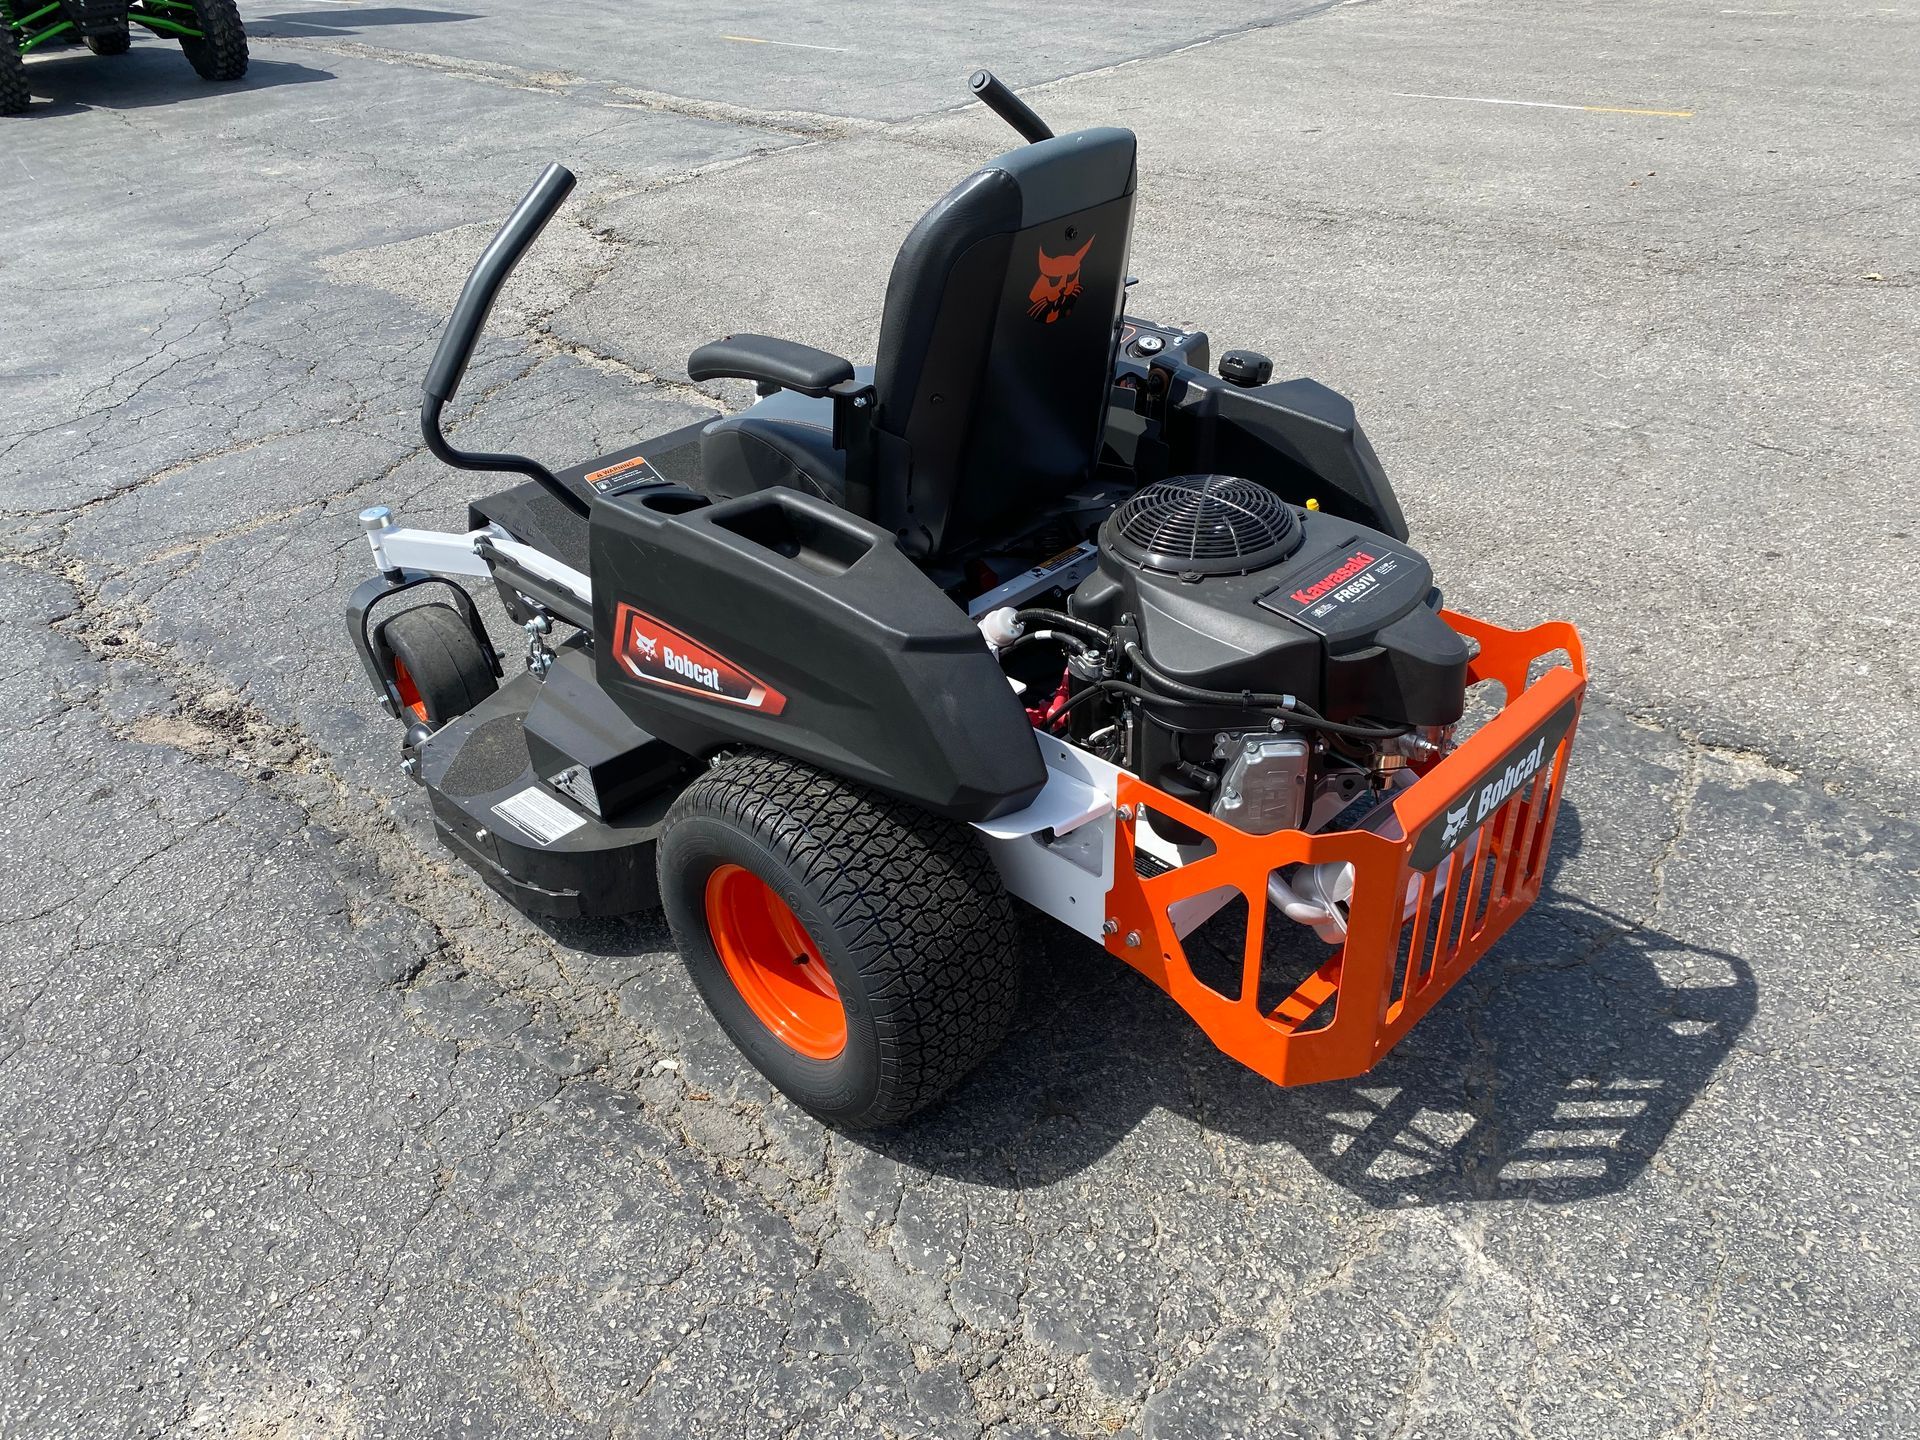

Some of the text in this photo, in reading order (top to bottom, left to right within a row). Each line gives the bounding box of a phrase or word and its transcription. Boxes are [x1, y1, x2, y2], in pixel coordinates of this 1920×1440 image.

[603, 461, 635, 476] WARNING
[1290, 551, 1376, 605] Kawasaki
[1333, 572, 1377, 603] FR651V
[663, 645, 720, 691] Bobcat
[1475, 736, 1546, 823] Bobcat
